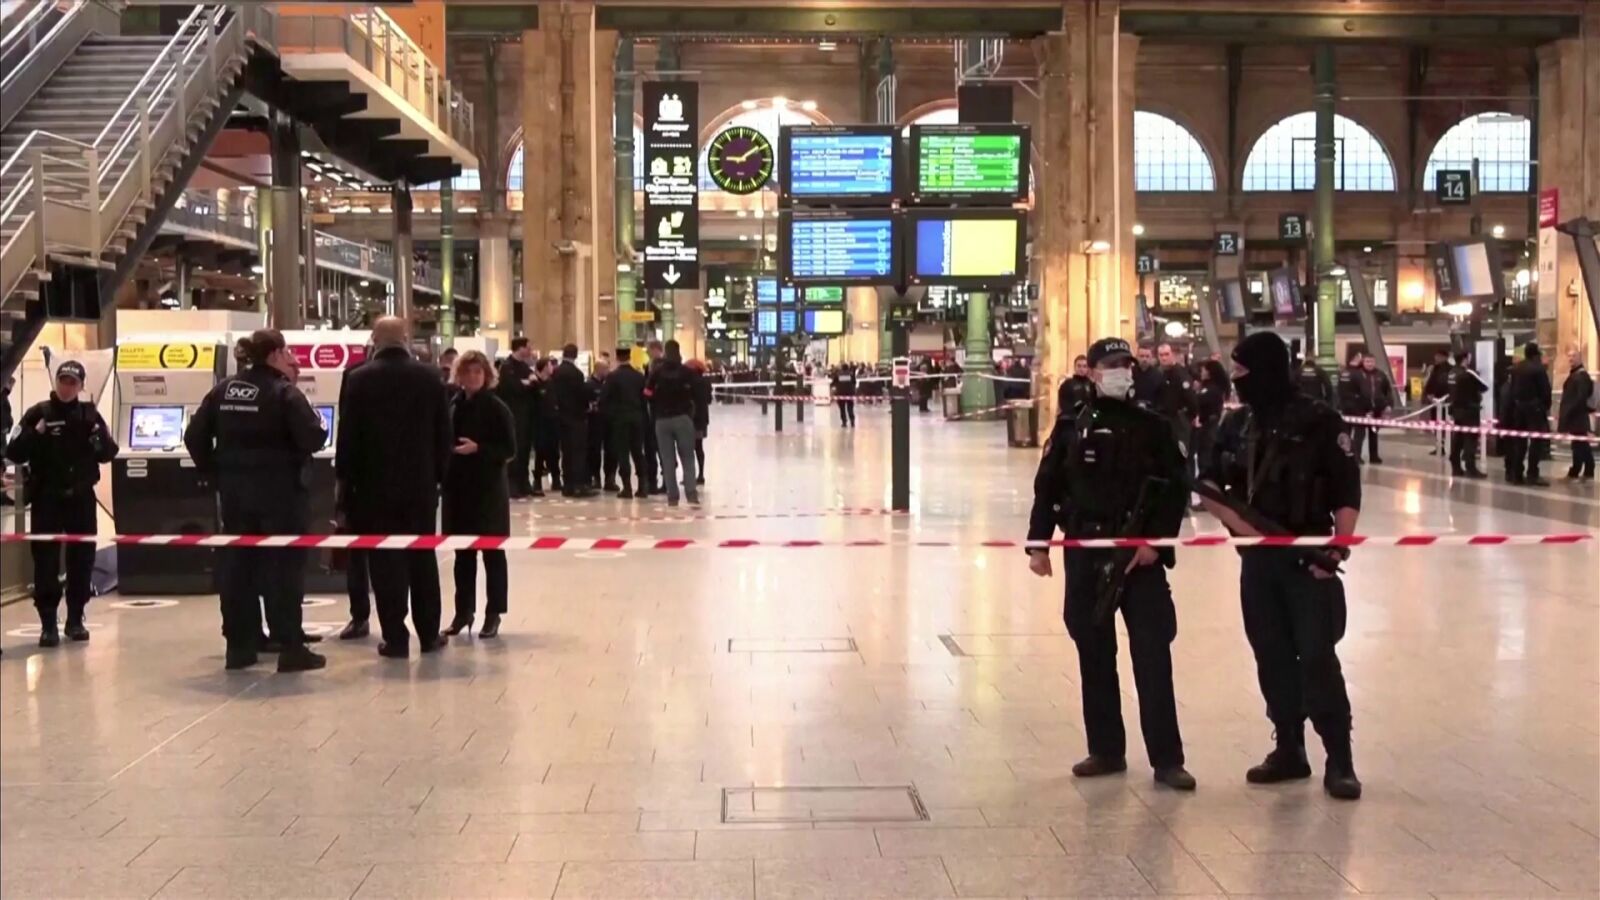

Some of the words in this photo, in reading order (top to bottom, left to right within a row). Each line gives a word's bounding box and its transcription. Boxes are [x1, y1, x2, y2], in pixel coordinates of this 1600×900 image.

[1443, 181, 1465, 197] 14
[1285, 223, 1301, 235] 13
[1219, 239, 1234, 251] 12
[227, 387, 257, 398] SNCF
